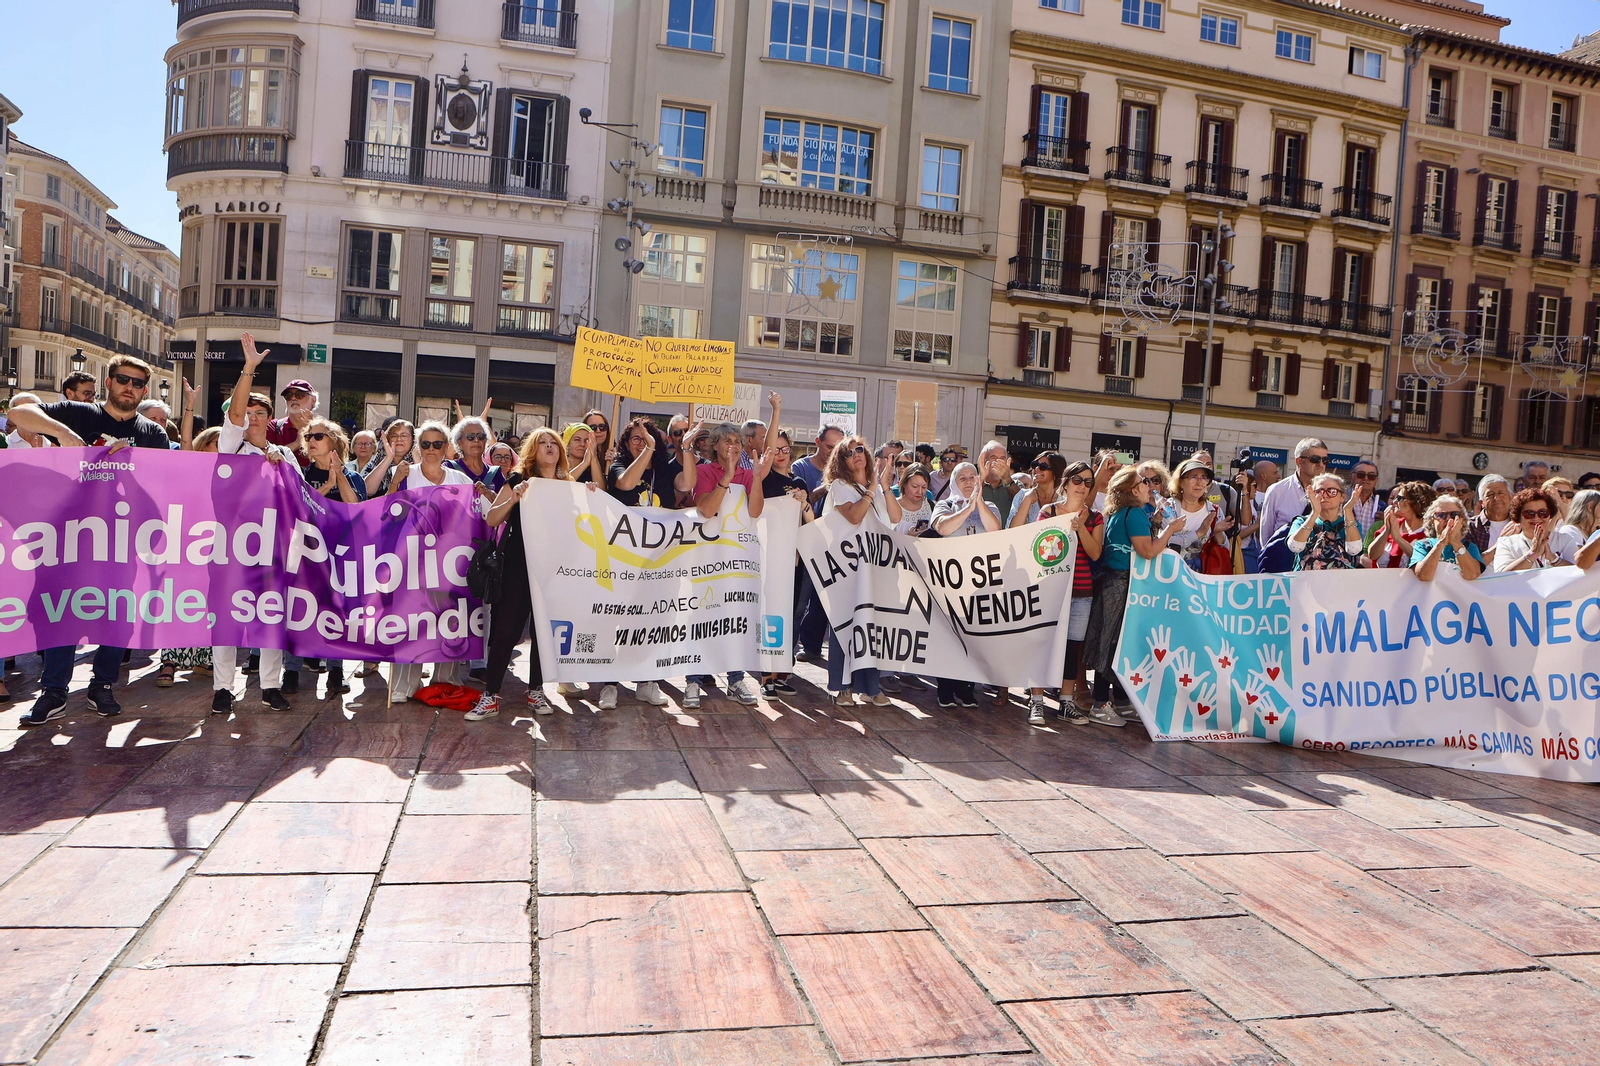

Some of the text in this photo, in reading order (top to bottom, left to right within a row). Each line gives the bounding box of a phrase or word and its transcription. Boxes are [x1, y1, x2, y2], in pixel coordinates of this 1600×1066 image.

[768, 135, 869, 158] FUNDACIÓN MÁLAGA
[179, 201, 282, 222] TEL LARIOS
[204, 350, 226, 360] SECRET
[582, 346, 637, 364] PROTOCOLOS
[645, 339, 732, 355] NO QUEREMOS LIMOSNAS
[685, 364, 723, 374] UNIDADES
[607, 374, 634, 396] YA!
[650, 381, 726, 397] FUNCIONEN!
[734, 384, 756, 401] BLICA
[695, 404, 749, 423] CIVILIZACIÓN
[1010, 439, 1059, 450] SCALPERS
[1172, 444, 1209, 452] LODGIG
[79, 460, 136, 472] Podemos
[1331, 458, 1351, 466] GANSO
[79, 470, 116, 483] Málaga
[0, 501, 476, 598] anidad Públic
[810, 531, 915, 588] LA SANIDA
[556, 565, 617, 580] Asociación
[619, 569, 635, 581] de
[637, 568, 674, 582] Afectadas
[675, 567, 688, 578] de
[927, 553, 1004, 589] NO SE
[40, 578, 216, 629] vende,
[592, 603, 603, 614] NO
[604, 601, 625, 615] ESTÁS
[650, 596, 699, 614] ADAEC
[724, 591, 745, 603] LUCHA
[959, 584, 1042, 626] VENDE
[1128, 592, 1291, 635] por la SANIDAD
[614, 616, 748, 646] YA NO SOMOS INVISIBLES
[1301, 599, 1493, 666] ¡MÁLAGA
[656, 654, 702, 668] WWW.ADAEC.ES
[1301, 668, 1600, 707] SANIDAD PÚBLICA DIG
[1301, 738, 1346, 752] CERO
[1444, 729, 1478, 751] MÁS
[1481, 731, 1534, 757] CAMAS
[1541, 731, 1579, 761] MÁS
[1584, 736, 1600, 761] C
